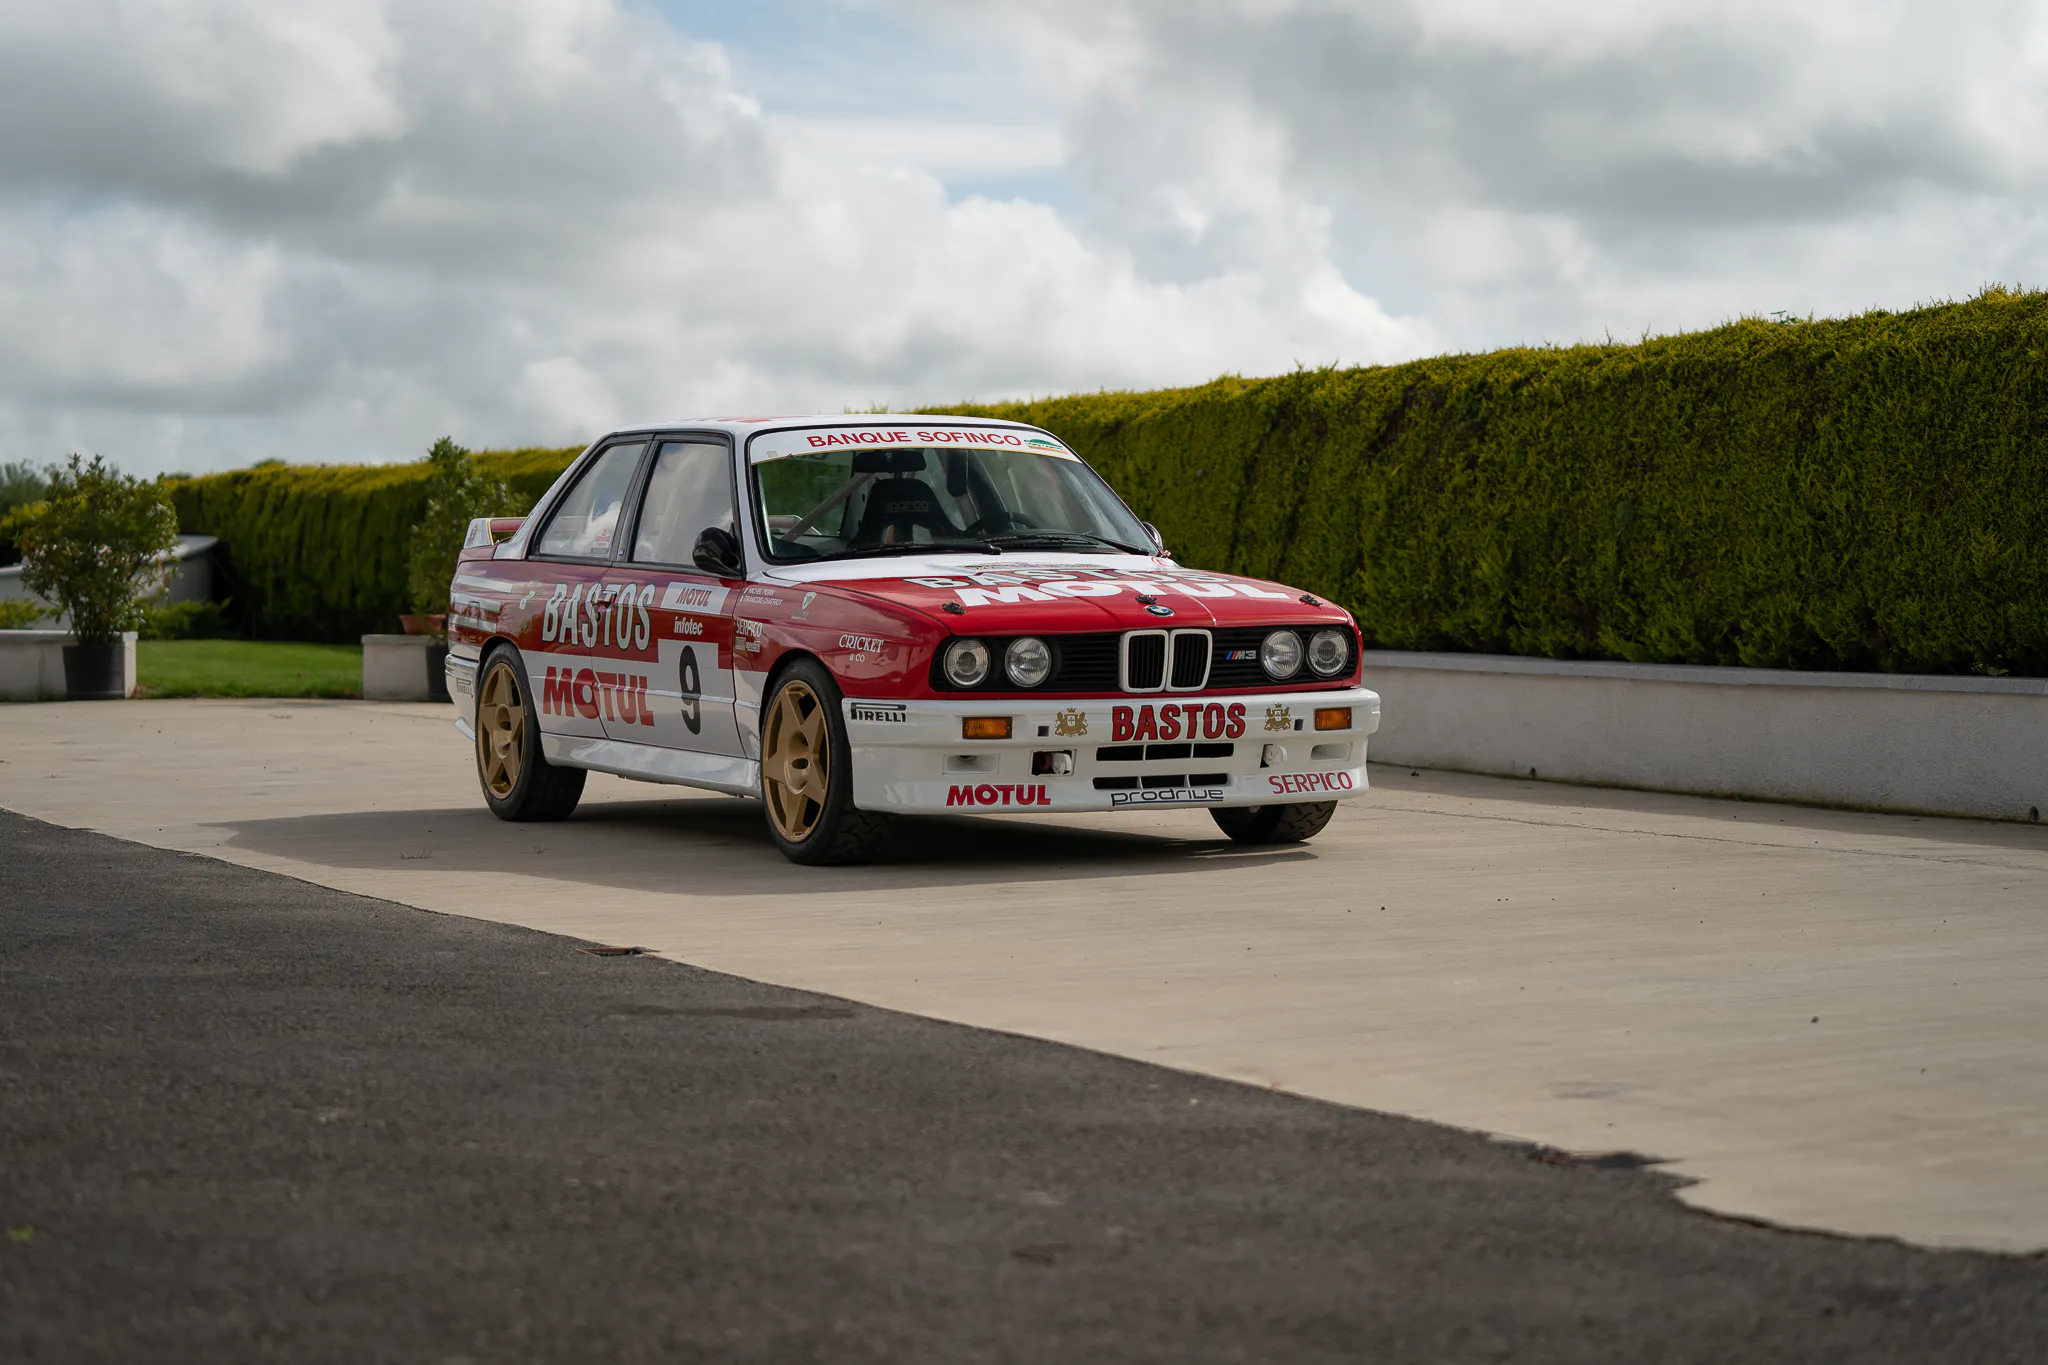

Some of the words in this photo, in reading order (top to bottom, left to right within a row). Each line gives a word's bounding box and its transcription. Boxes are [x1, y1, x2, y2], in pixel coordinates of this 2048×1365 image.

[807, 431, 912, 448] BANQUE
[916, 431, 1021, 447] SOFINCO
[676, 588, 713, 607] MOTUL
[953, 580, 1290, 607] MOTUL
[541, 582, 657, 650] BASTOS
[674, 616, 703, 635] infotec
[735, 617, 763, 638] SERPICO
[839, 634, 884, 653] CRICKET
[849, 653, 855, 662] &
[855, 653, 865, 663] CO
[1233, 650, 1257, 660] M3
[542, 666, 656, 727] MOTUL
[679, 645, 701, 735] 9
[851, 702, 907, 723] PIRELLI
[1112, 703, 1247, 741] BASTOS
[1268, 771, 1353, 795] SERPICO
[946, 784, 1052, 807] MOTUL
[1111, 788, 1225, 806] prodrive
